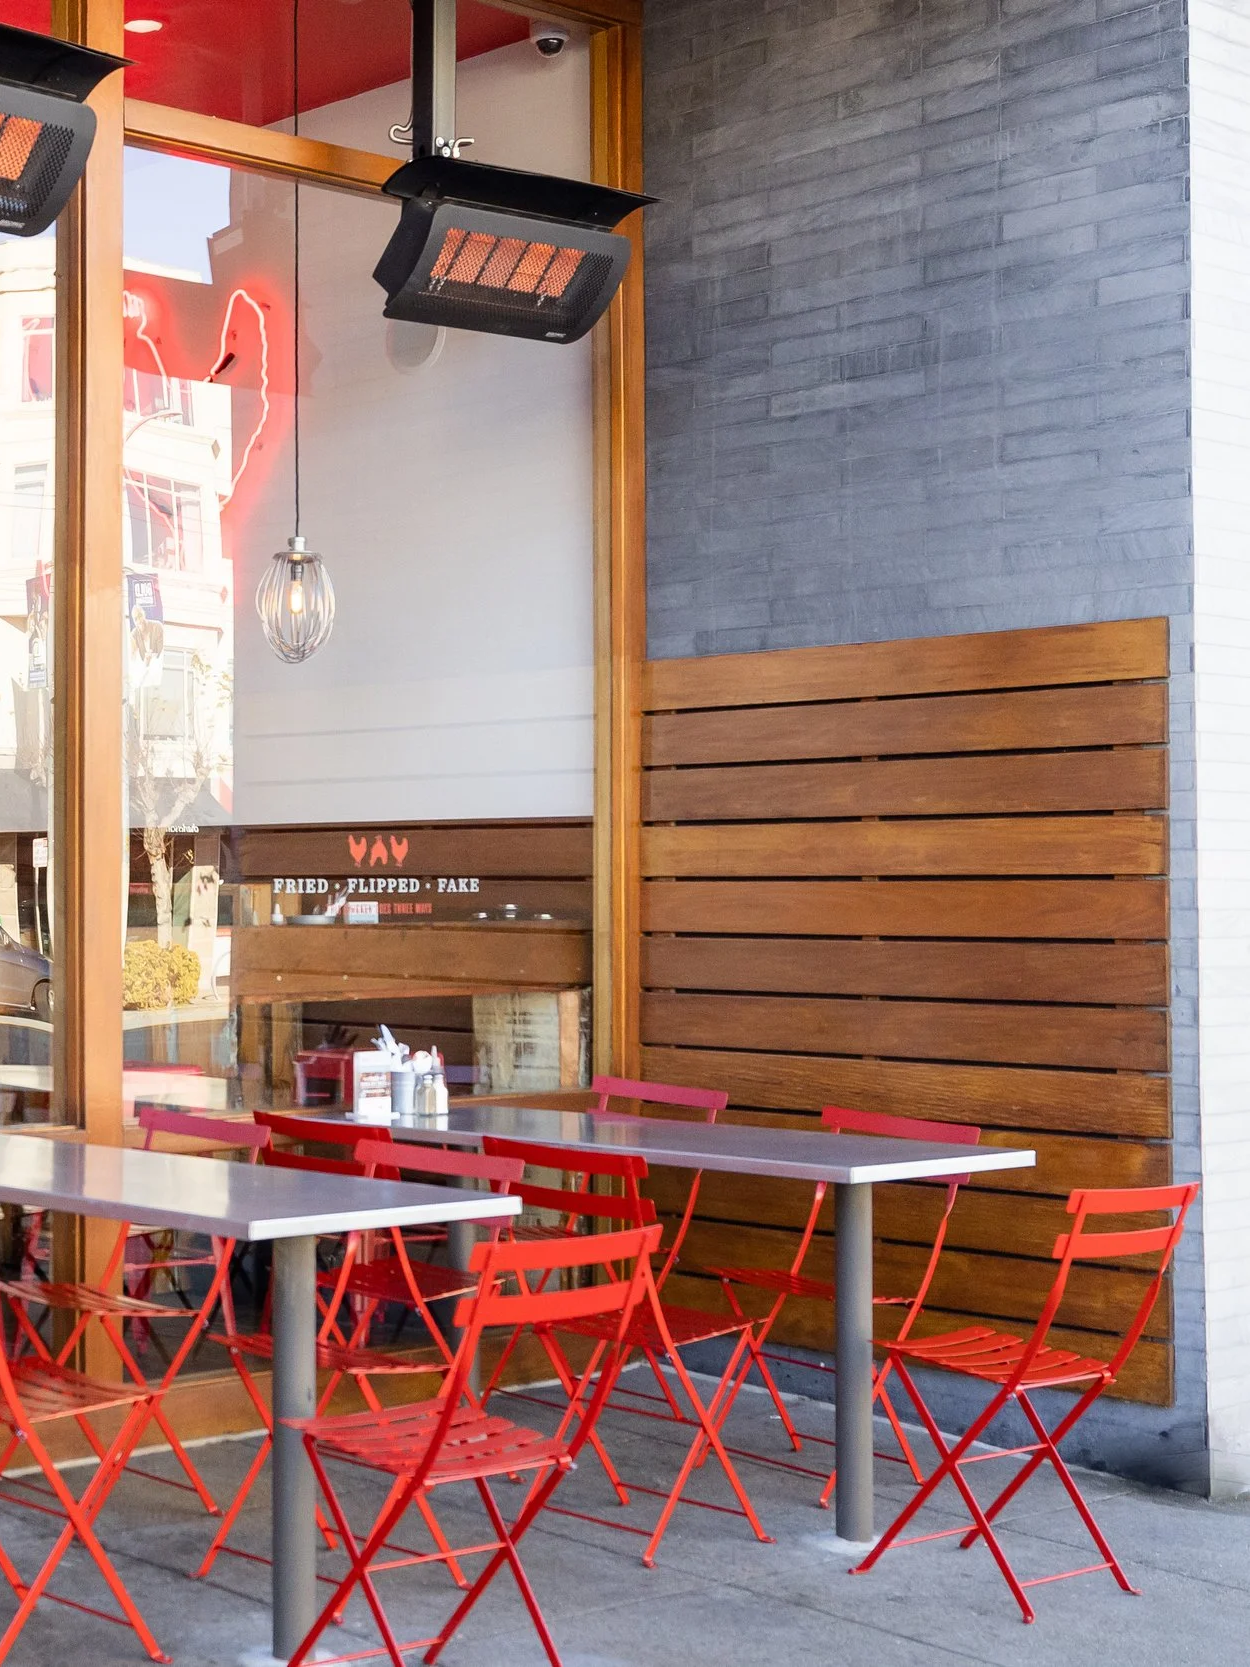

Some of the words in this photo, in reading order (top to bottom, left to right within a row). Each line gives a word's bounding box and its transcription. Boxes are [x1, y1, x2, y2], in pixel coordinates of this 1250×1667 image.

[272, 878, 329, 894] FRIED
[346, 878, 421, 893] FLIPPED
[437, 878, 480, 893] FAKE
